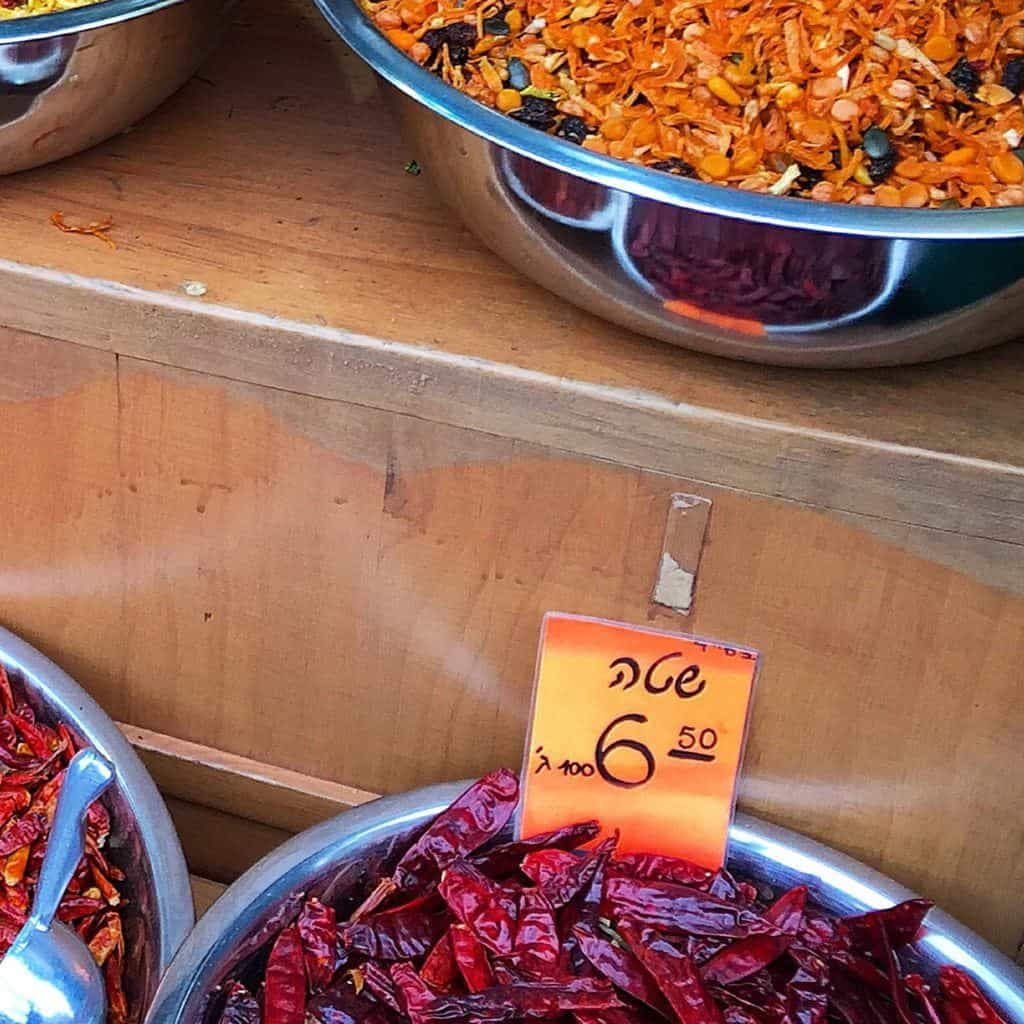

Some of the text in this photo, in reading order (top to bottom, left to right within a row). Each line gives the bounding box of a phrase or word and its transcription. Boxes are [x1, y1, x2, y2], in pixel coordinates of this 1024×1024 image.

[608, 651, 707, 699] שטה
[557, 758, 595, 777] 100
[594, 712, 719, 790] 6 50
